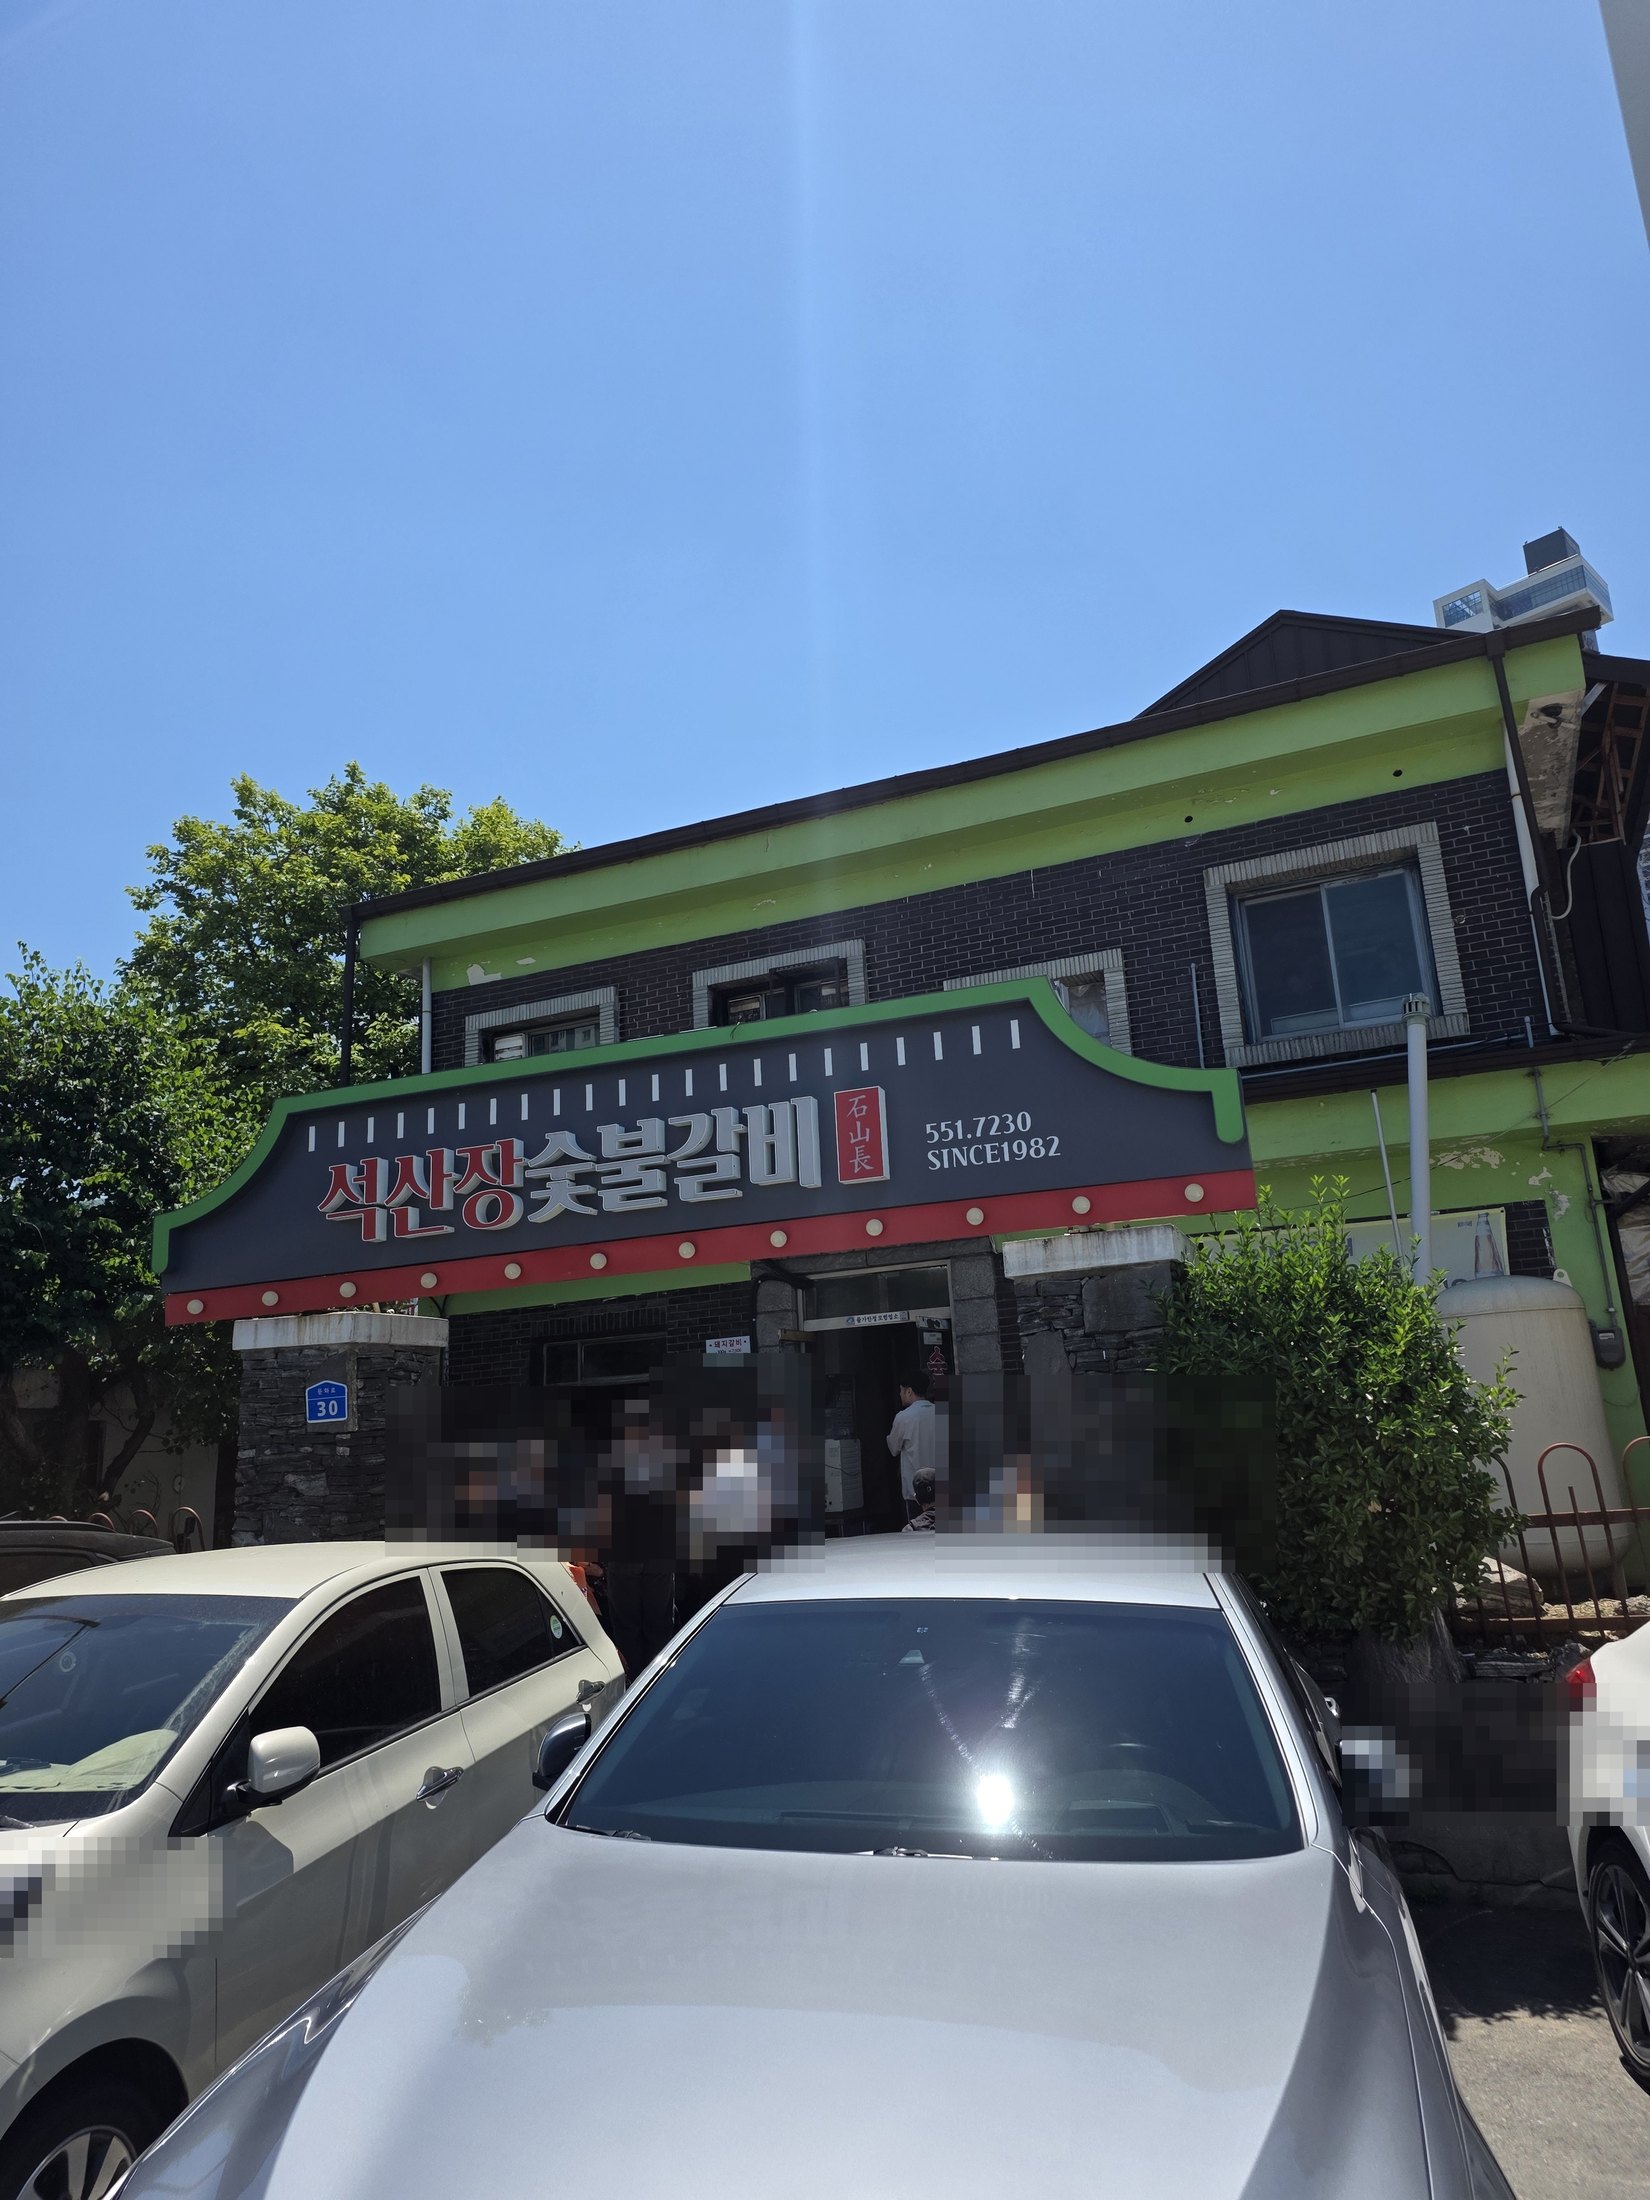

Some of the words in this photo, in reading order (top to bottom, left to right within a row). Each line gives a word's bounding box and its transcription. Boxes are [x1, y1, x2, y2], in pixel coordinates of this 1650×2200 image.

[847, 1094, 874, 1174] 石山長
[925, 1111, 1032, 1144] 551.7230
[317, 1400, 338, 1417] 30
